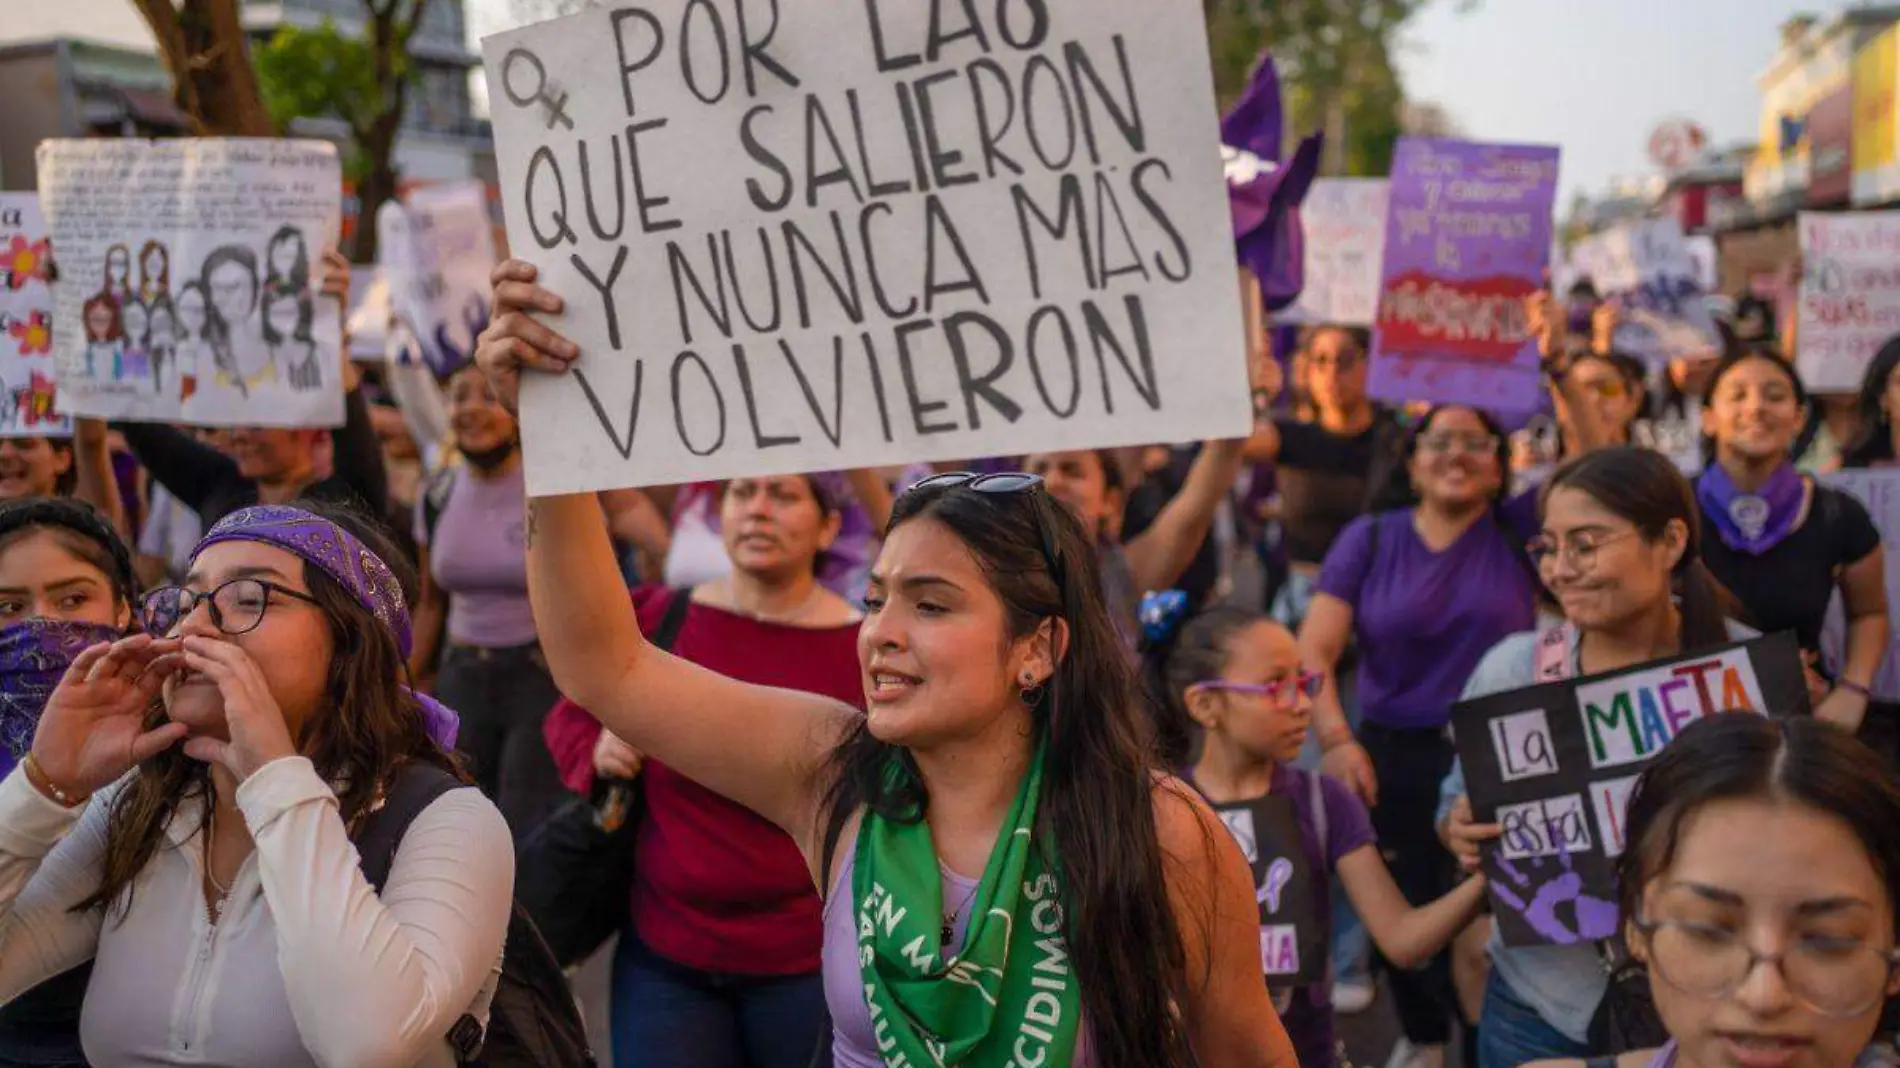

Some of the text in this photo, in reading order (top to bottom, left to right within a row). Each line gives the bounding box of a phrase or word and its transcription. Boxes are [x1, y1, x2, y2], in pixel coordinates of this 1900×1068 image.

[610, 0, 801, 117] POR
[525, 117, 683, 250] QUE
[739, 33, 1146, 213] SALIERON
[571, 244, 629, 351] Y
[666, 193, 992, 344] NUNCA
[1010, 157, 1192, 300] MÁS
[572, 294, 1162, 460] VOLVIERON
[1500, 719, 1552, 774] La
[1502, 800, 1589, 852] está
